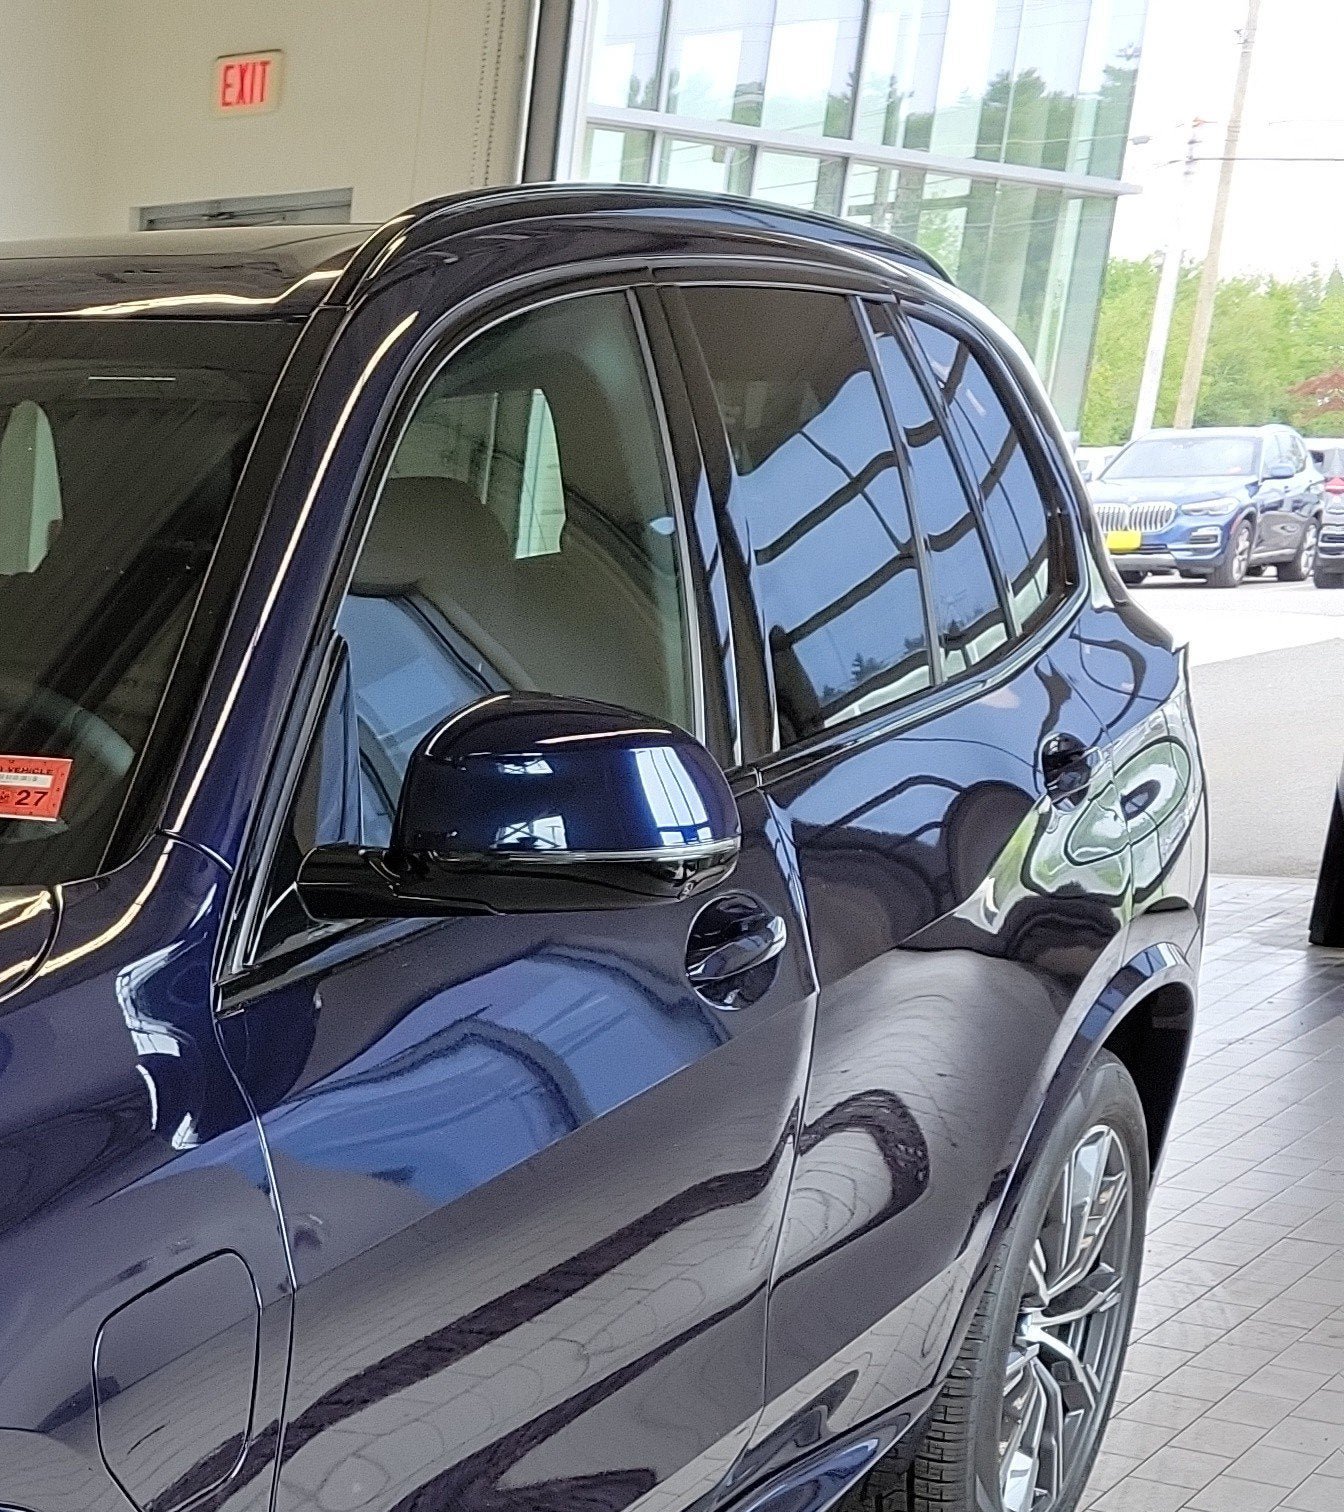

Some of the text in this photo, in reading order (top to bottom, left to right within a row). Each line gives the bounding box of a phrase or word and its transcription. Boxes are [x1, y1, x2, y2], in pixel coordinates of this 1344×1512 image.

[221, 61, 270, 107] EXIT
[8, 766, 54, 776] VEHICLE
[14, 789, 49, 807] 27
